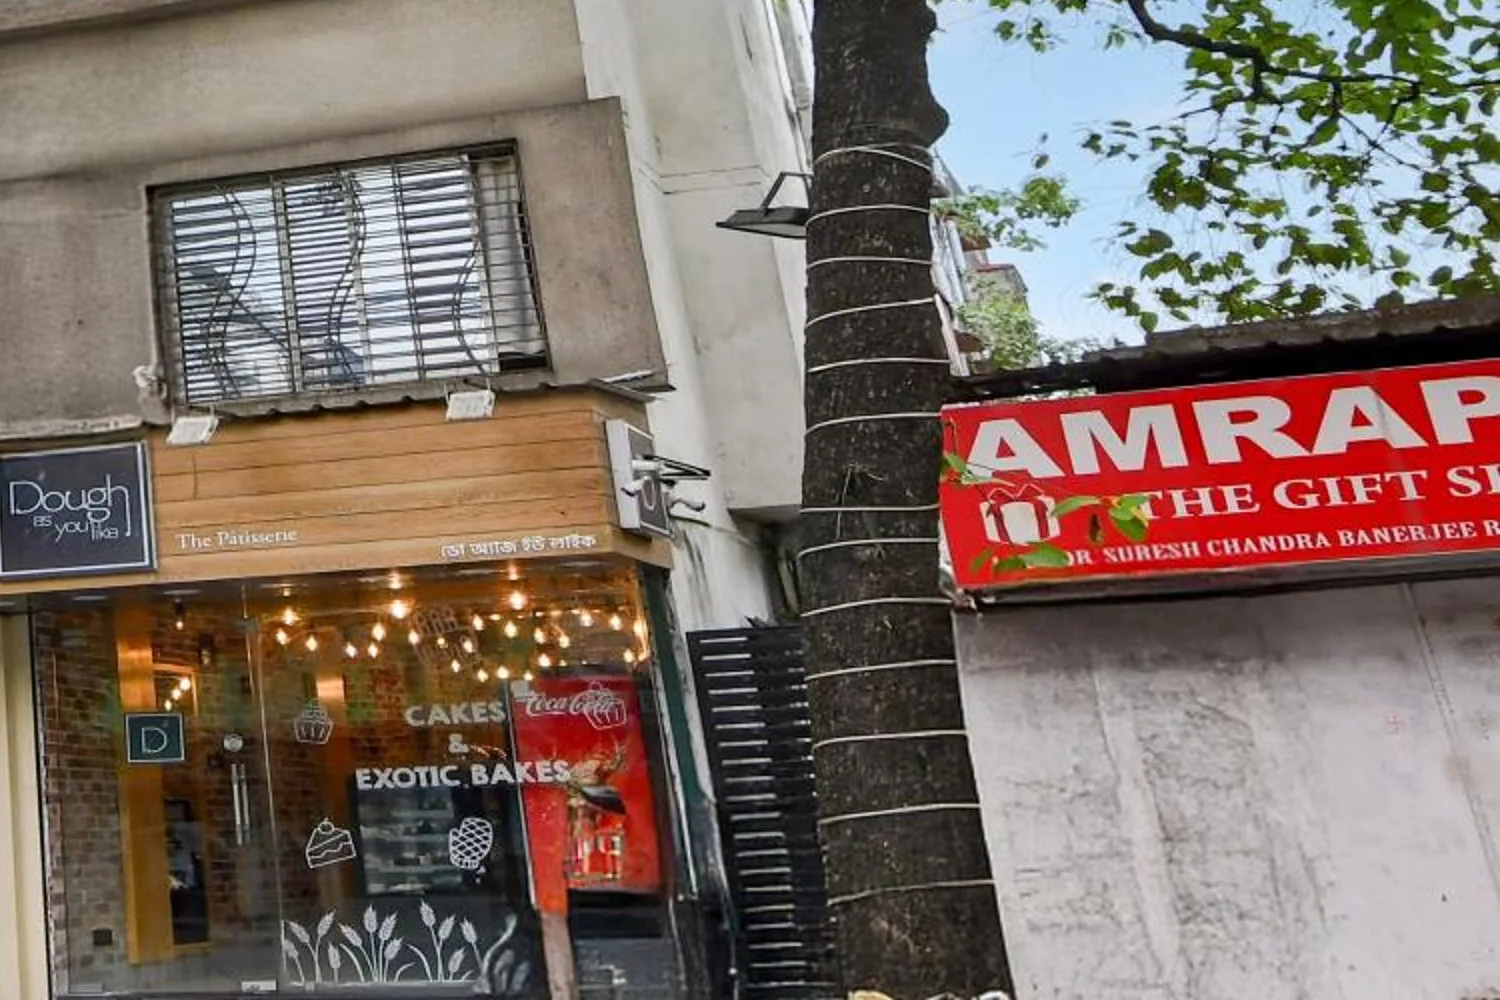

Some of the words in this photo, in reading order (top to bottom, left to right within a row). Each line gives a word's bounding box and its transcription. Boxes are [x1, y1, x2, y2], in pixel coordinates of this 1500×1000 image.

[1272, 469, 1428, 509] GIFT
[9, 473, 131, 537] Dough
[55, 520, 89, 543] you
[177, 532, 213, 549] The
[1102, 540, 1201, 564] SURESH
[1206, 531, 1332, 557] CHANDRA
[1337, 520, 1478, 548] BANERJEE
[404, 701, 507, 727] CAKES
[141, 726, 168, 754] D
[448, 733, 470, 753] &
[355, 765, 460, 791] EXOTIC
[470, 759, 572, 787] BAKES
